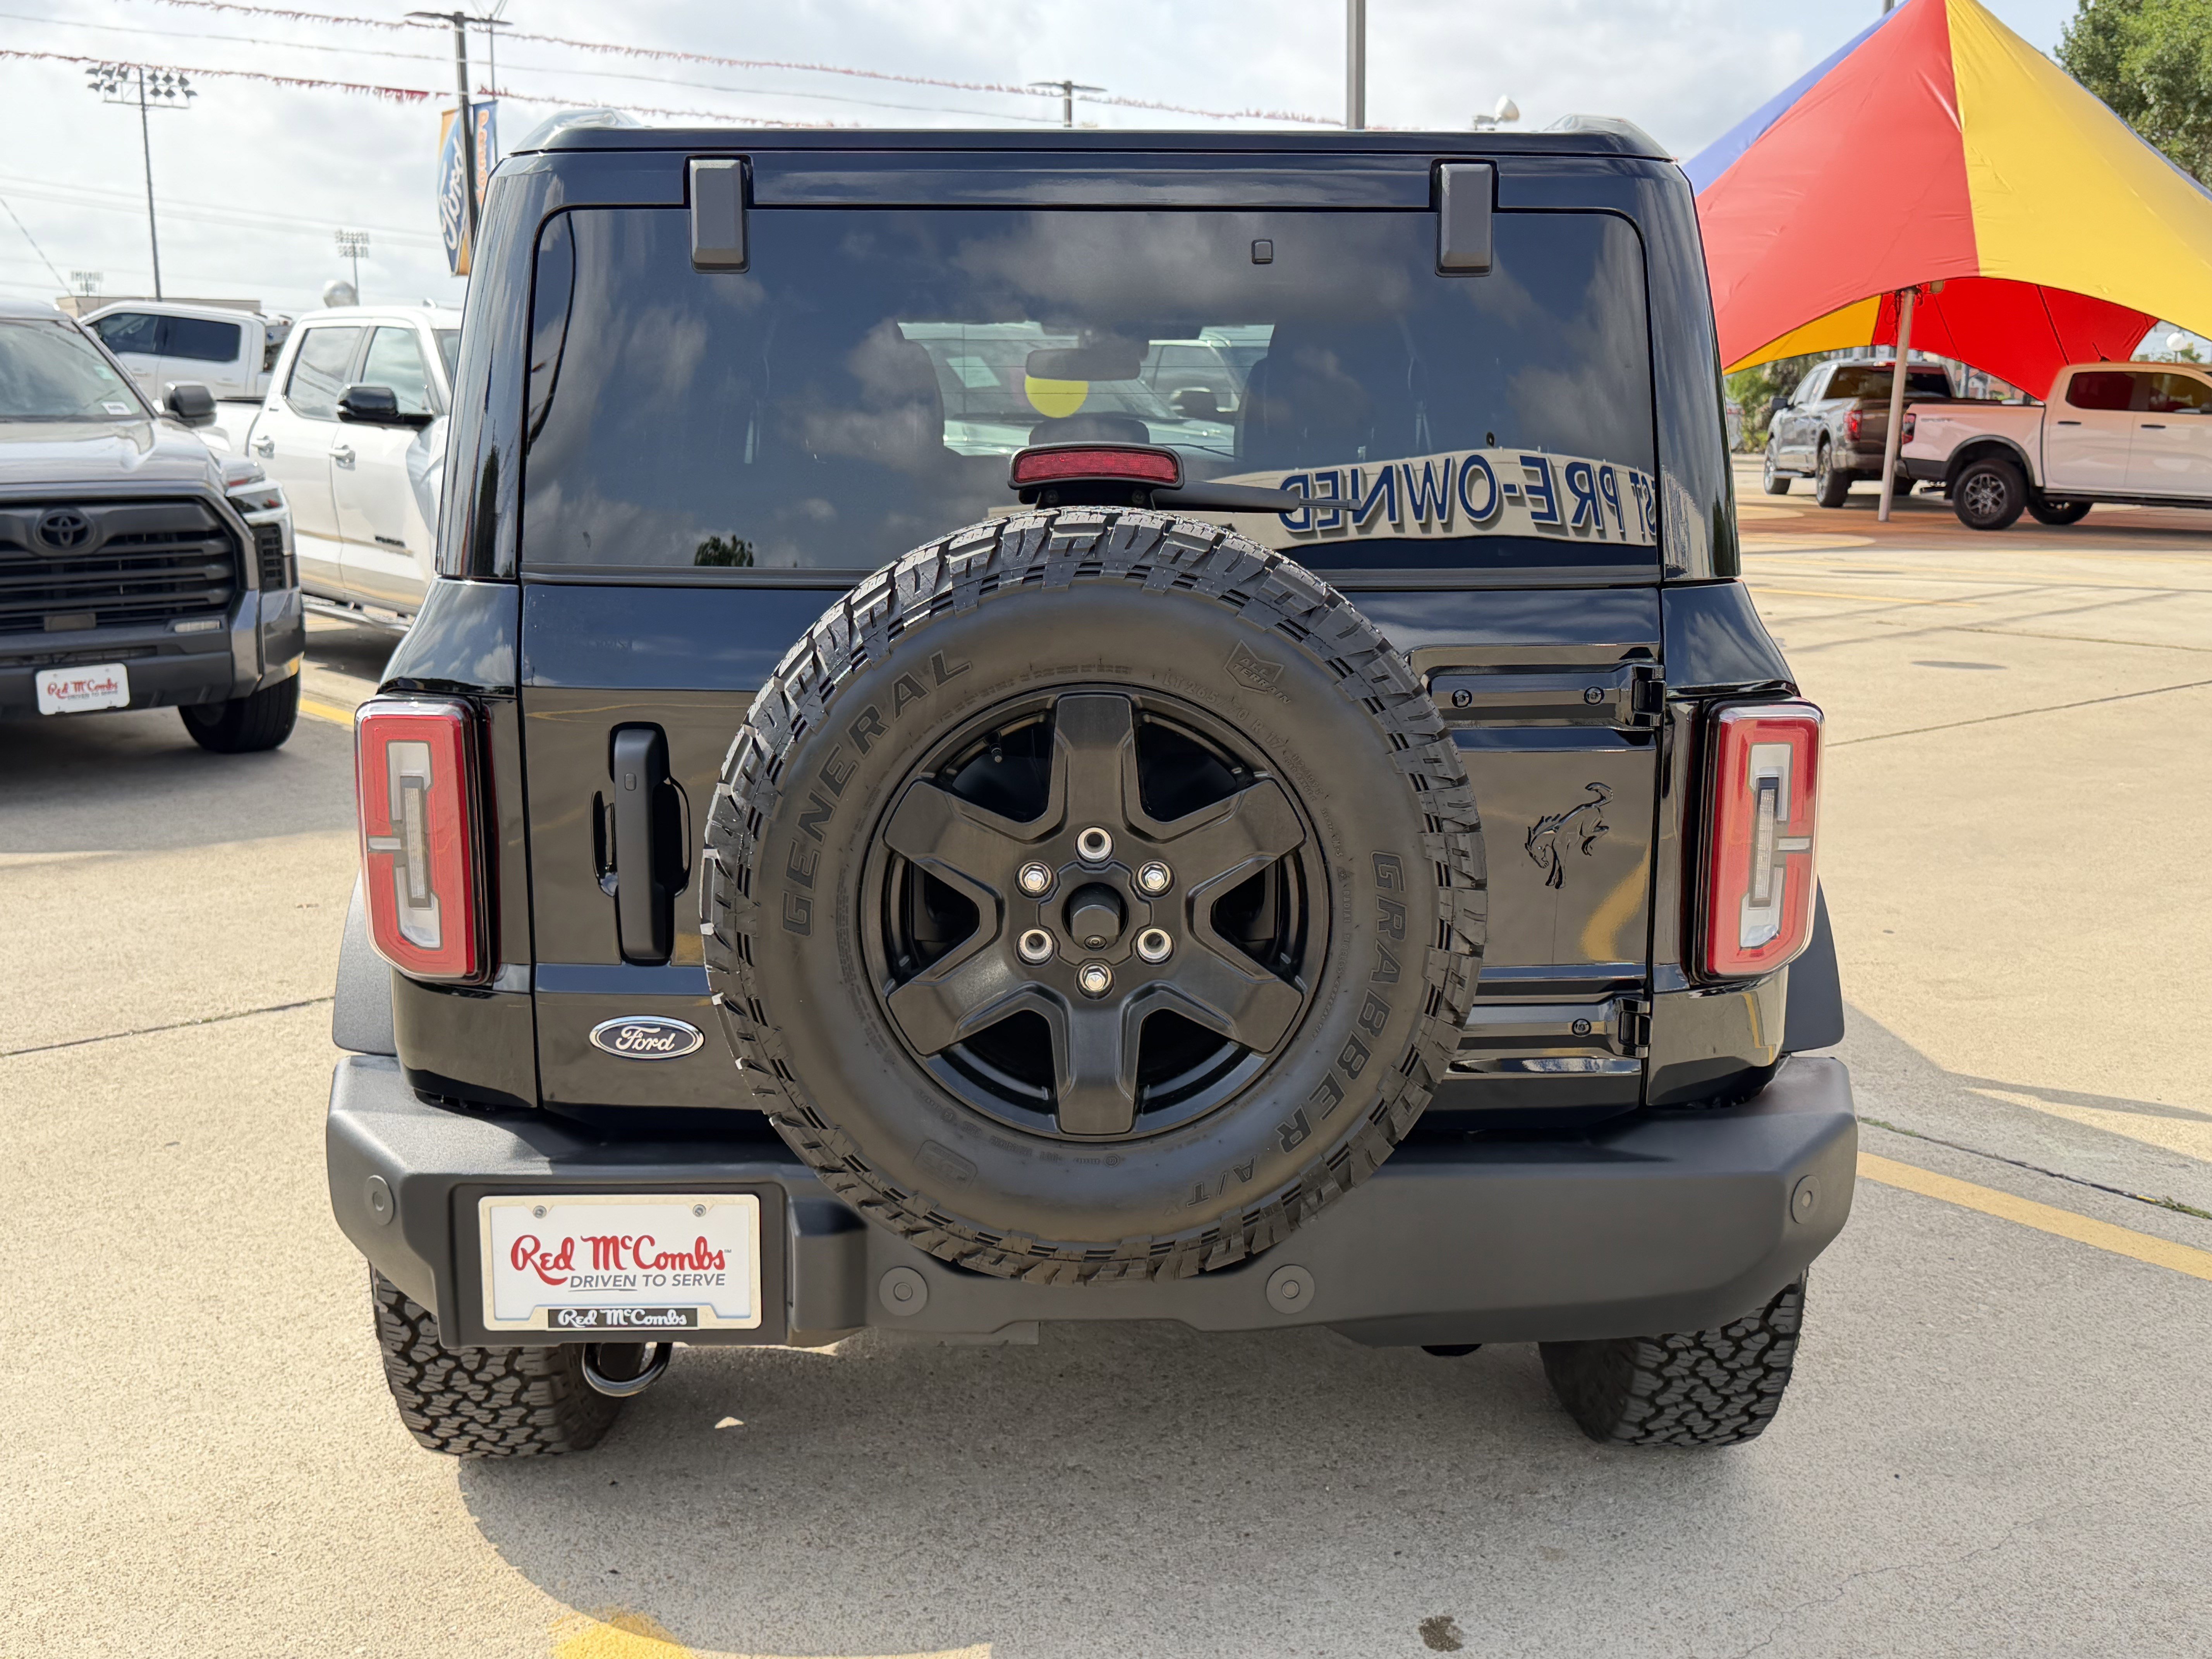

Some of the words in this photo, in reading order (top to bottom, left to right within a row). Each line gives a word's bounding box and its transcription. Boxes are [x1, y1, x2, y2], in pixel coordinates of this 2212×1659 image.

[440, 136, 463, 250] Ford
[1232, 663, 1291, 705] TERRAIN
[1238, 656, 1270, 675] ALL
[780, 649, 972, 936] GENERAL
[1274, 851, 1408, 1154] GRABBER
[615, 1026, 675, 1052] Ford
[510, 1234, 575, 1286] Red
[580, 1234, 725, 1271] McCombs
[570, 1274, 637, 1288] DRIVEN
[643, 1274, 666, 1287] TO
[672, 1273, 726, 1287] SERVE
[558, 1309, 597, 1328] Red
[600, 1308, 687, 1326] McCombs
